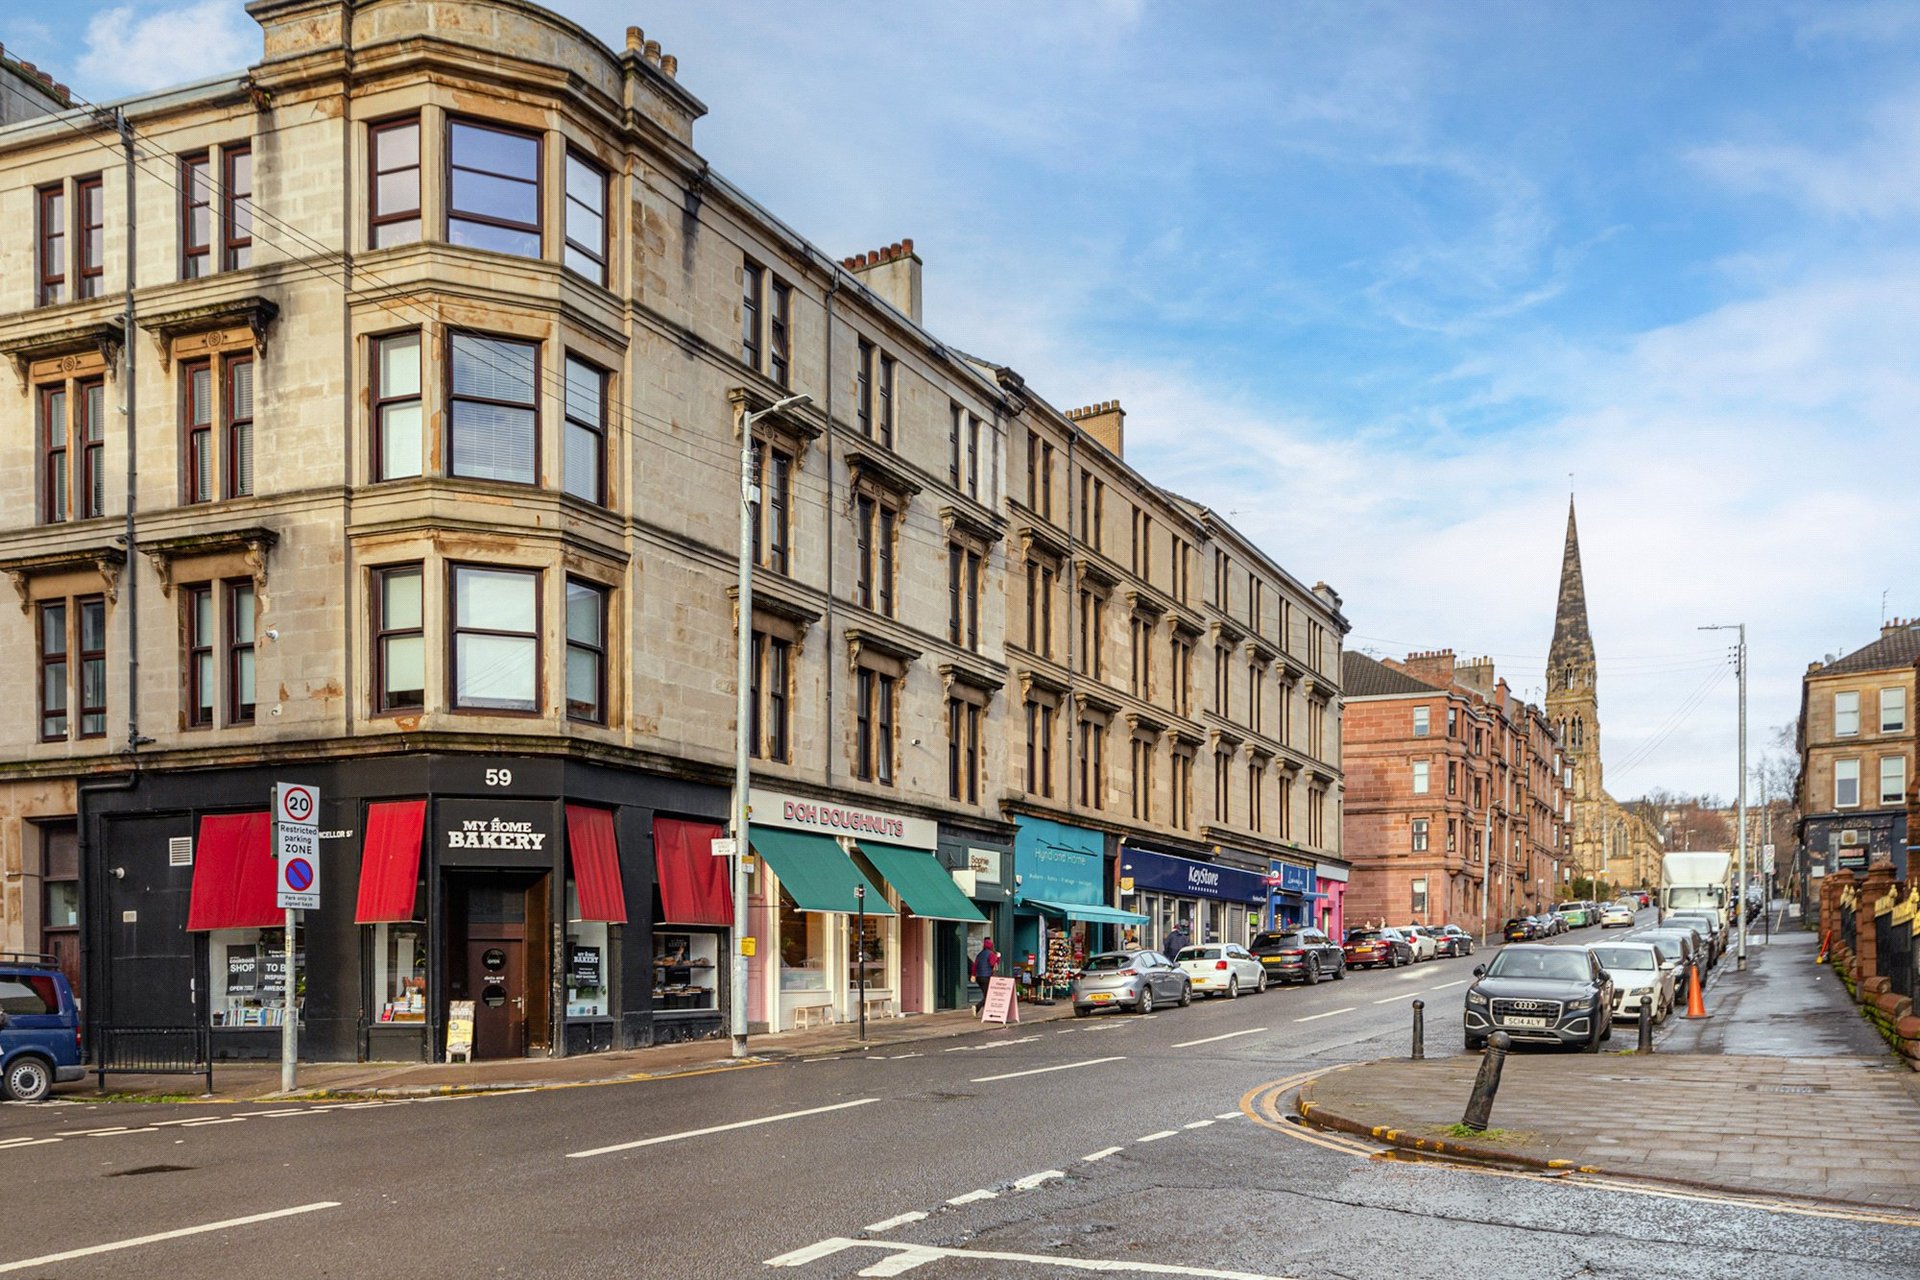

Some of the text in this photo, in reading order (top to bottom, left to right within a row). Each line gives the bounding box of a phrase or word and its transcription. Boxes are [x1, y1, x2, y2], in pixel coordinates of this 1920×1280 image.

[485, 768, 512, 786] 59
[289, 796, 309, 812] 20
[462, 818, 532, 832] MY HOME
[783, 800, 904, 838] DOH DOUGHNUTS
[280, 824, 317, 836] Restricted
[284, 834, 312, 844] parking
[447, 831, 546, 850] BAKERY
[285, 844, 312, 855] ZONE
[1188, 865, 1218, 887] KeyStore
[230, 963, 255, 973] SHOP
[266, 963, 279, 973] TO
